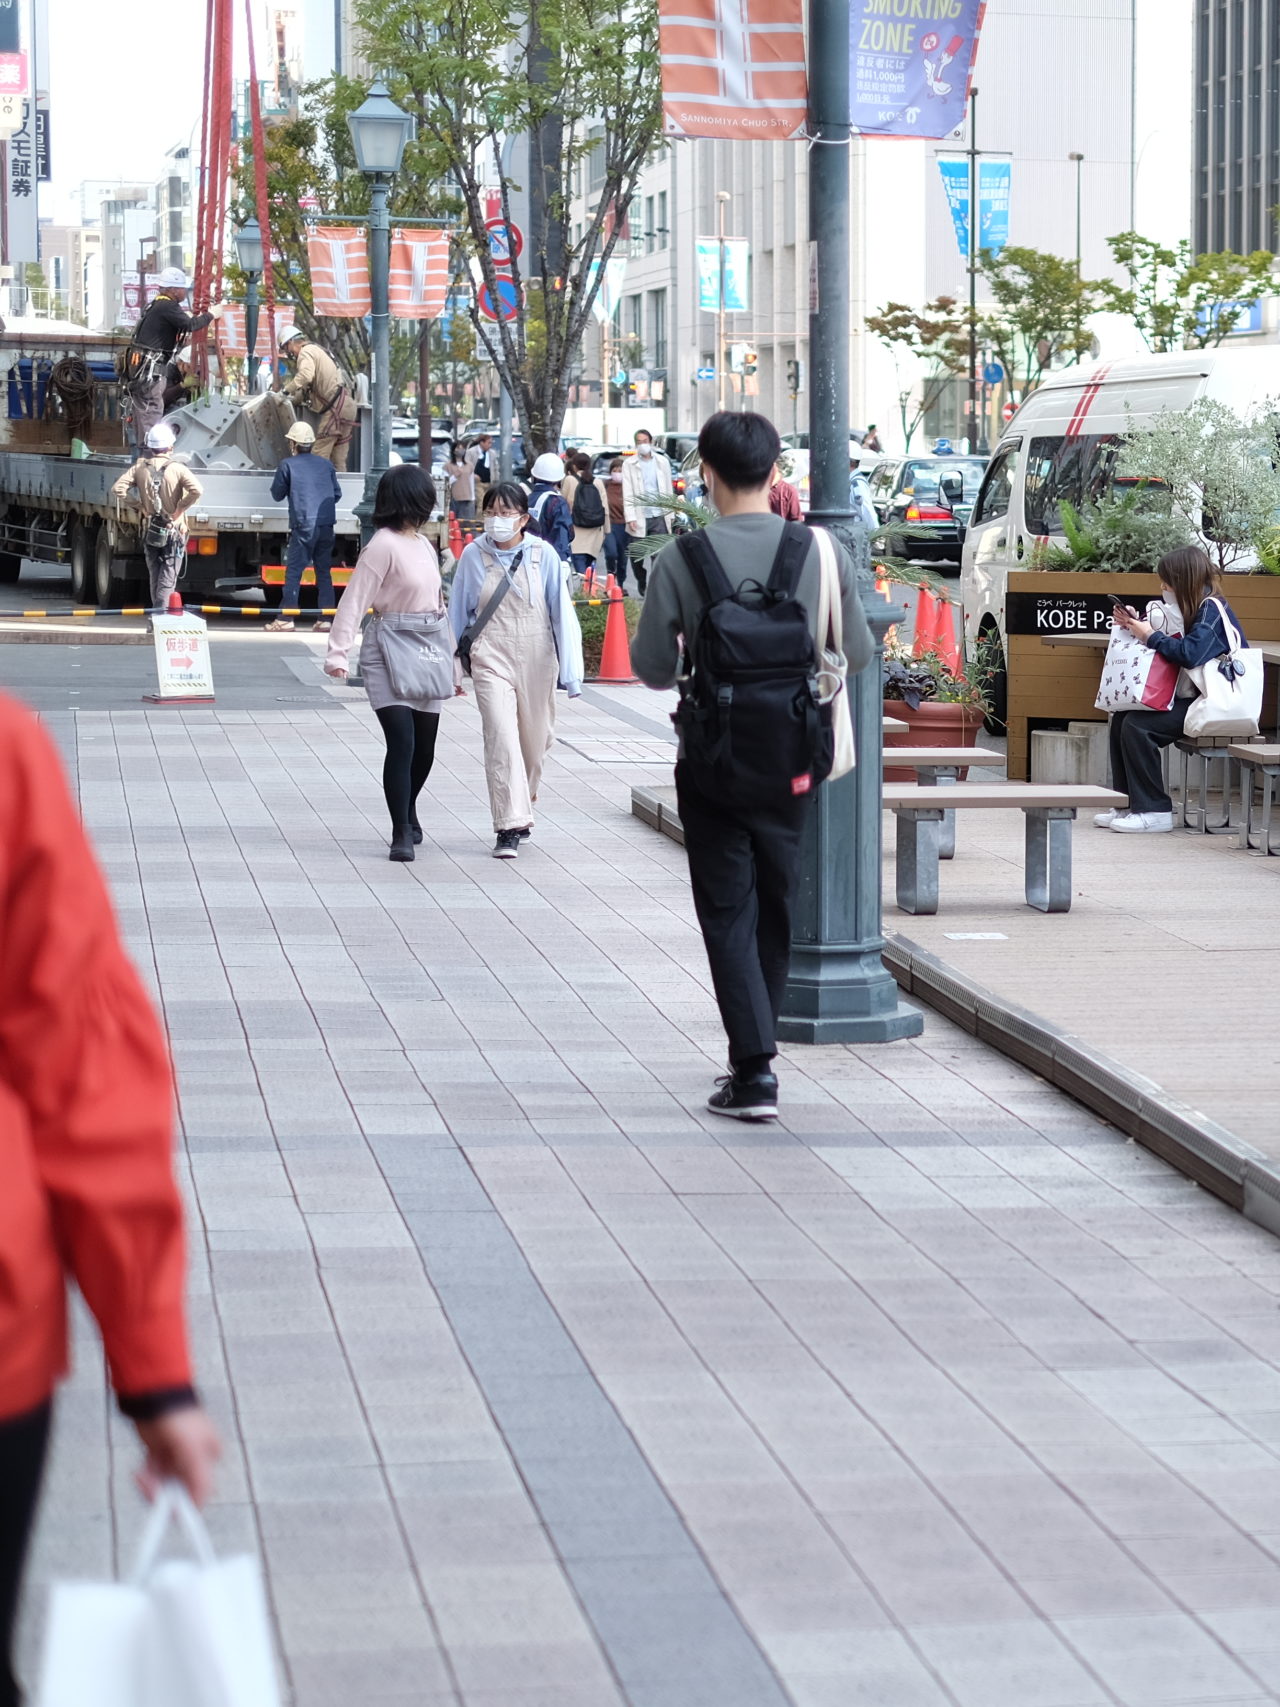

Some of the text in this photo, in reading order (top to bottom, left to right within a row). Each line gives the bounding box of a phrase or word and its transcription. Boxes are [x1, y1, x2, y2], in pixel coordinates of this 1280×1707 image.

[858, 19, 916, 54] ZONE
[680, 113, 738, 127] SANNOMIYA
[741, 118, 768, 128] CHUO
[1036, 599, 1088, 609] こうべ パークレット
[1037, 609, 1087, 629] KOBE
[166, 637, 201, 653] 仮歩道
